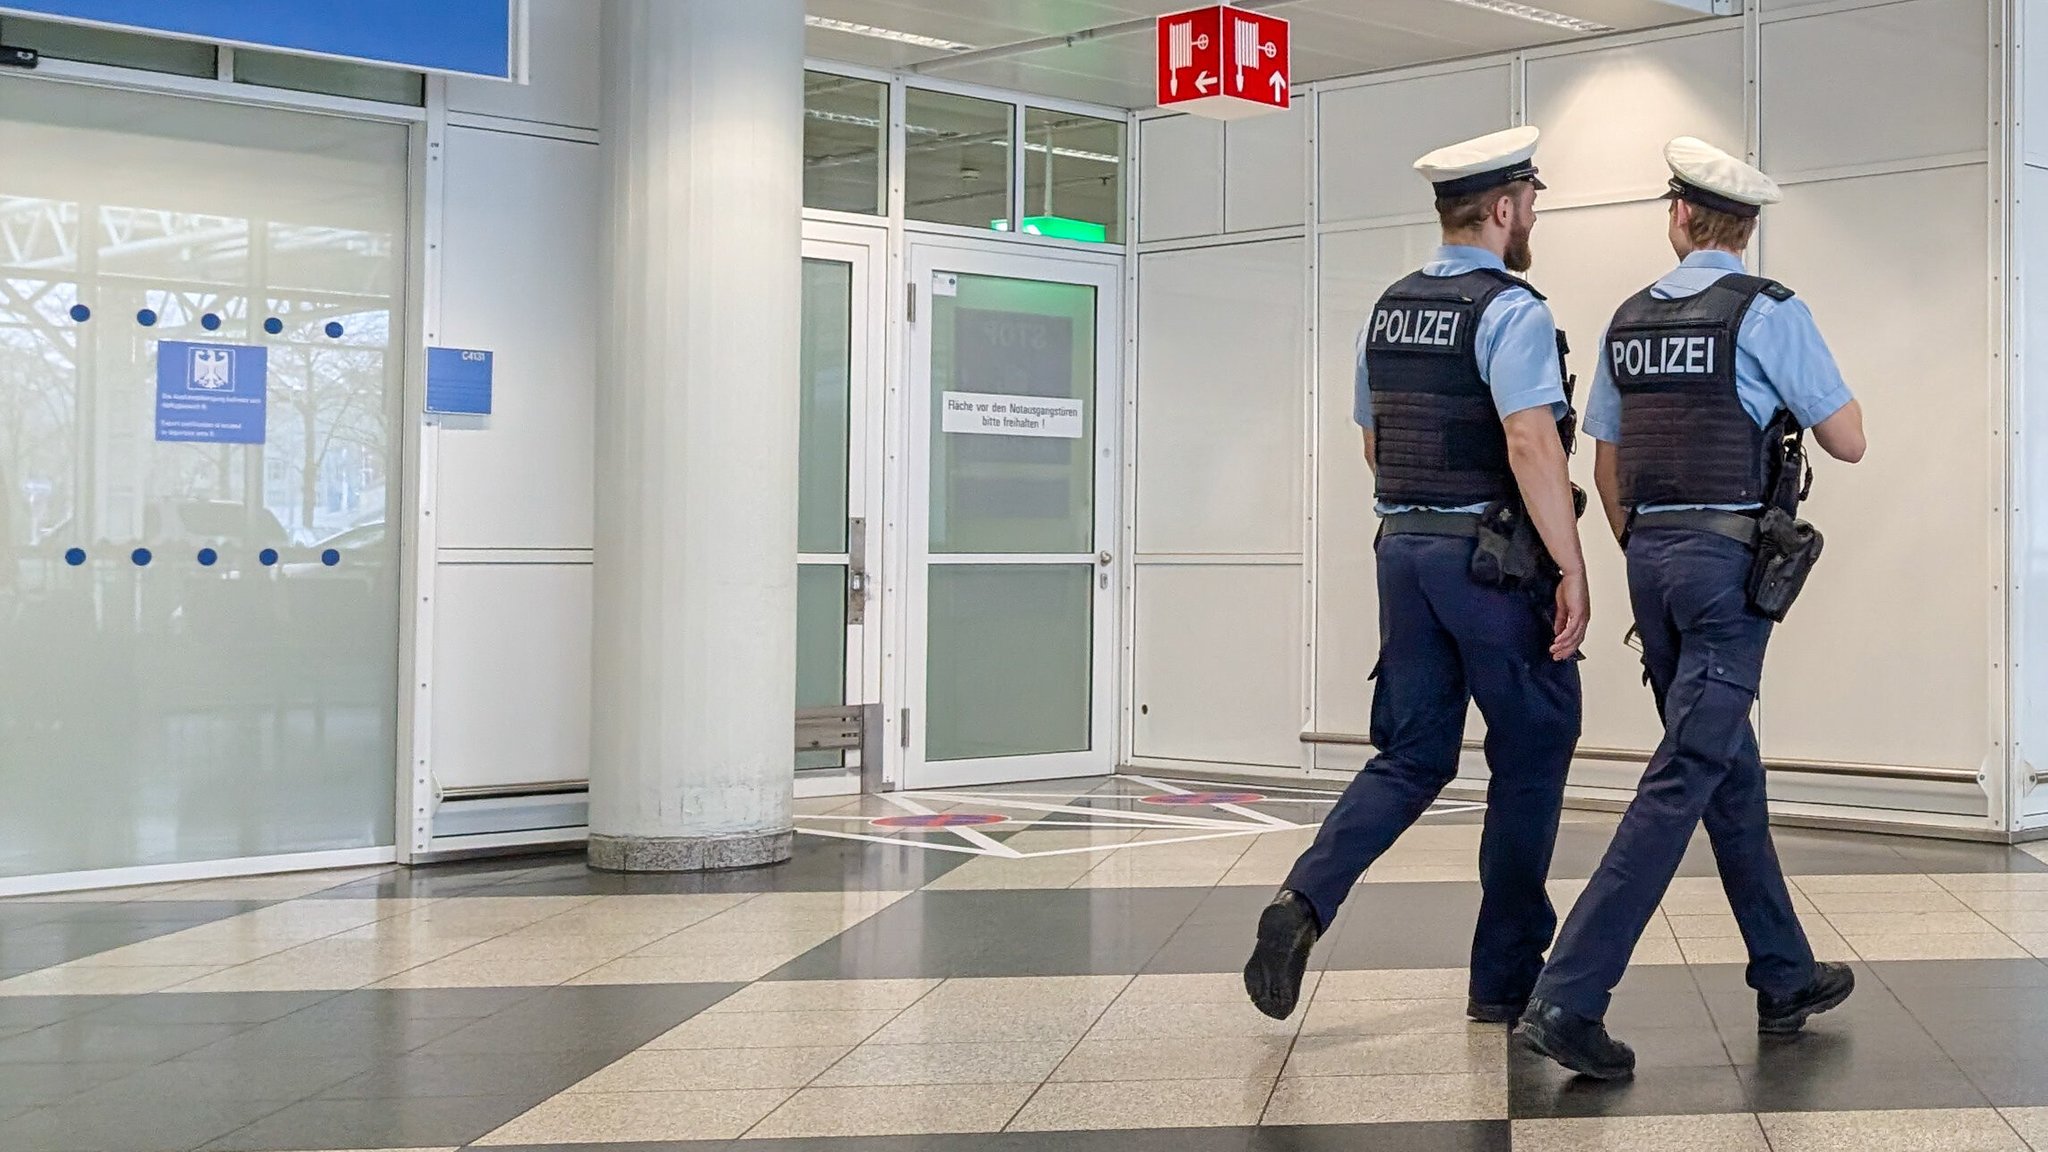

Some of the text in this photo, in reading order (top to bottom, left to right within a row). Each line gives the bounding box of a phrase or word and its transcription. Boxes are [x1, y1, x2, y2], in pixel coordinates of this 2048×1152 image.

[1371, 309, 1461, 346] POLIZEI
[1611, 337, 1715, 377] POLIZEI
[976, 403, 989, 412] vor
[992, 402, 1007, 413] den
[982, 416, 1001, 427] bitte
[1003, 417, 1040, 429] freihalten
